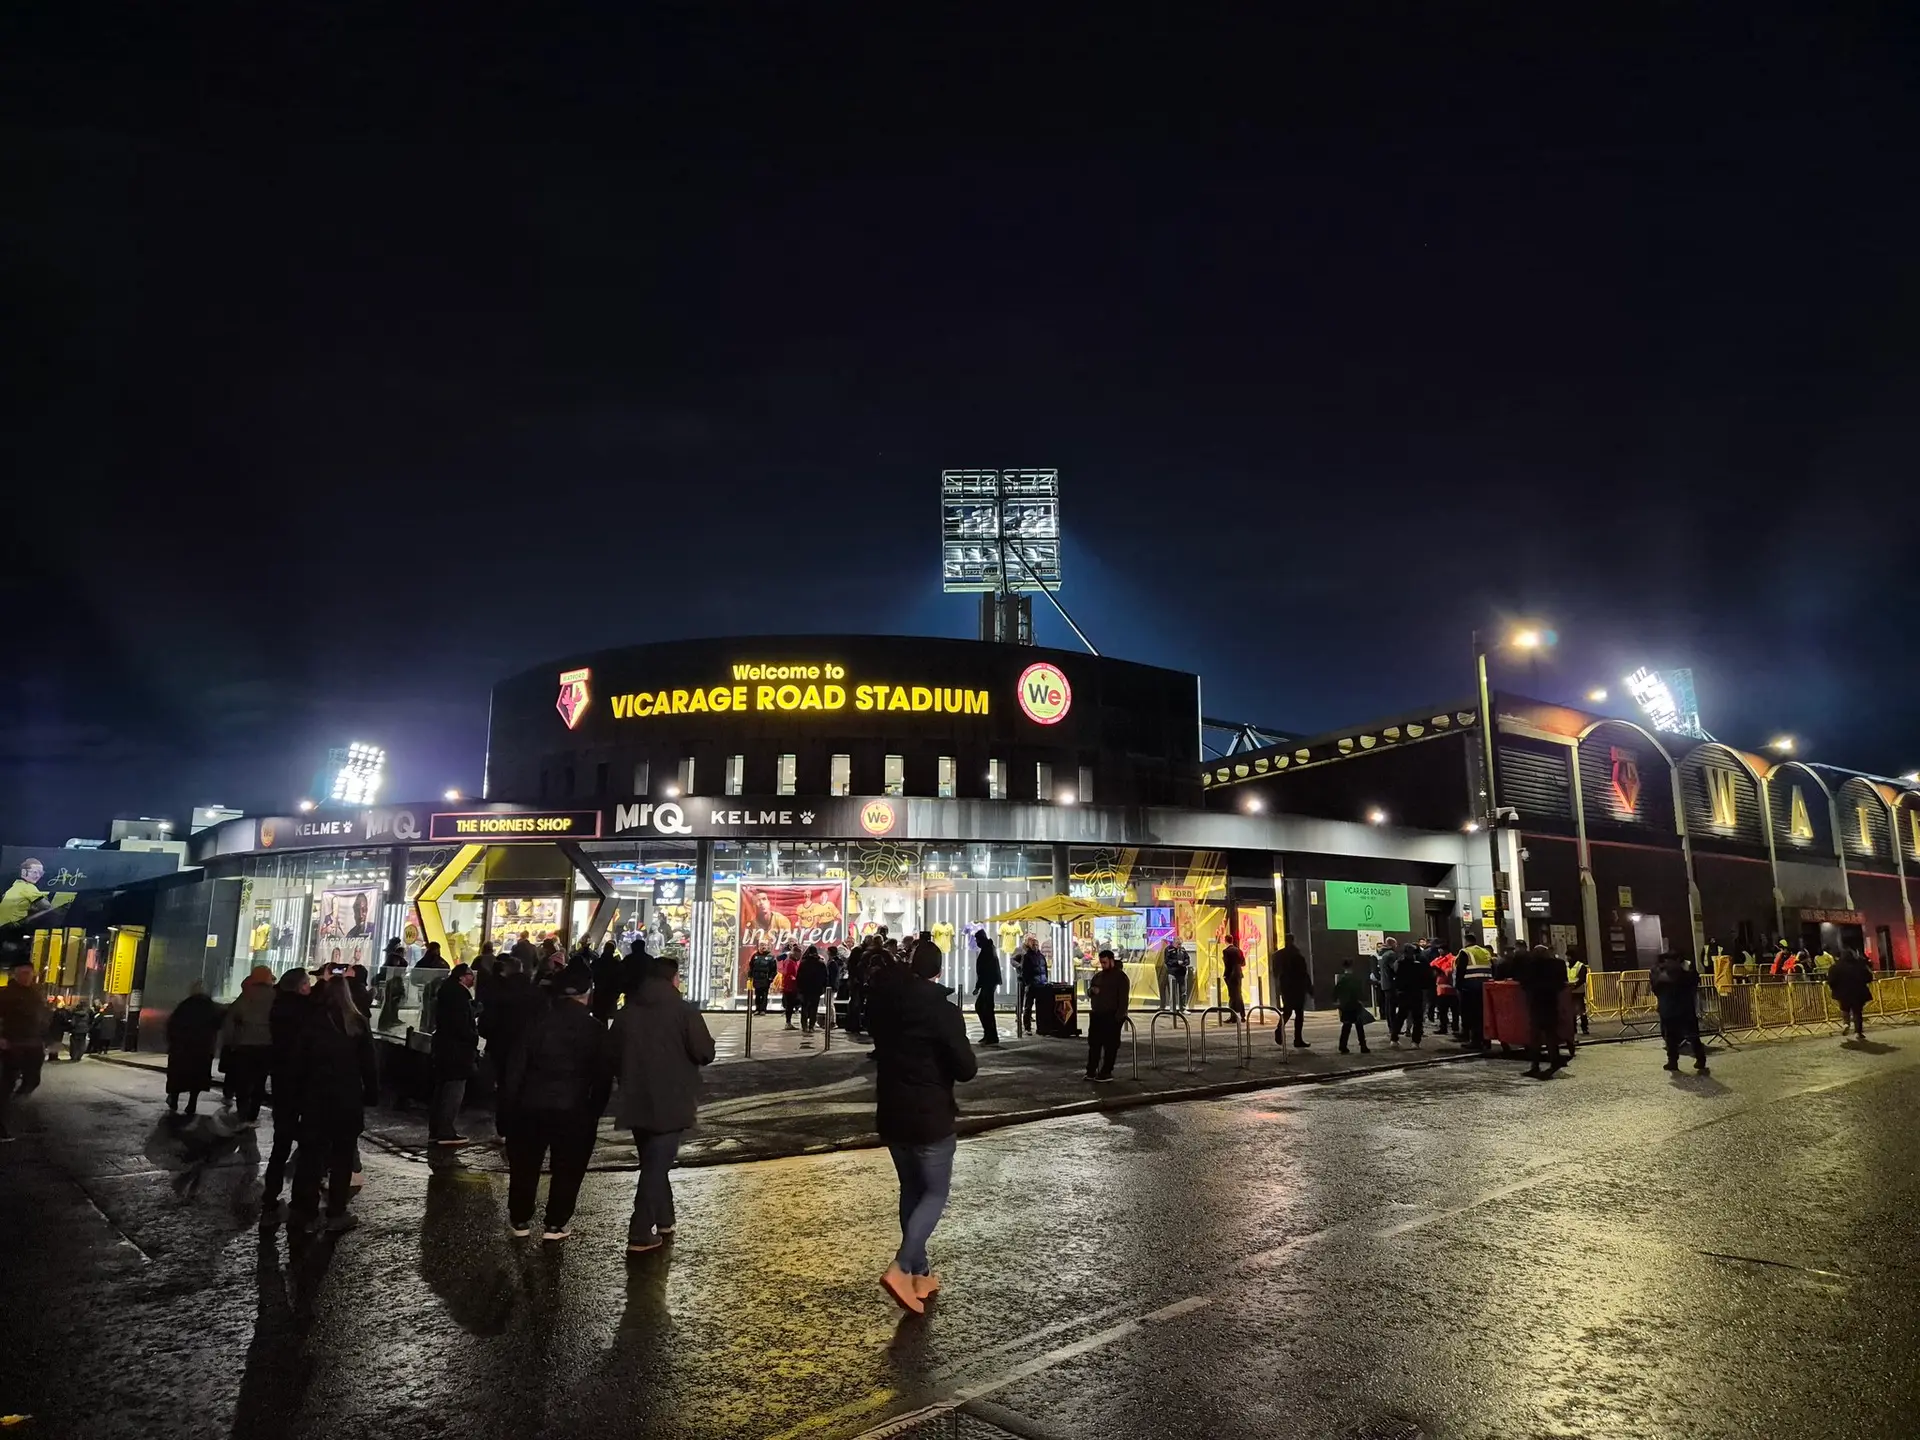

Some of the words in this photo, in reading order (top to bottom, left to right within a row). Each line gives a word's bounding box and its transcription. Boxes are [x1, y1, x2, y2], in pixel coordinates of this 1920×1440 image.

[733, 664, 820, 681] Welcome
[826, 663, 845, 680] to
[611, 686, 747, 719] VICARAGE
[757, 685, 846, 711] ROAD
[855, 685, 989, 715] STADIUM
[1028, 683, 1061, 706] We
[456, 820, 477, 832] THE
[480, 819, 533, 832] HORNETS
[537, 818, 572, 831] SHOP
[615, 803, 692, 834] MrQ
[711, 811, 793, 825] KELME
[867, 811, 889, 824] We
[295, 821, 341, 836] KELME
[742, 920, 840, 950] inspired
